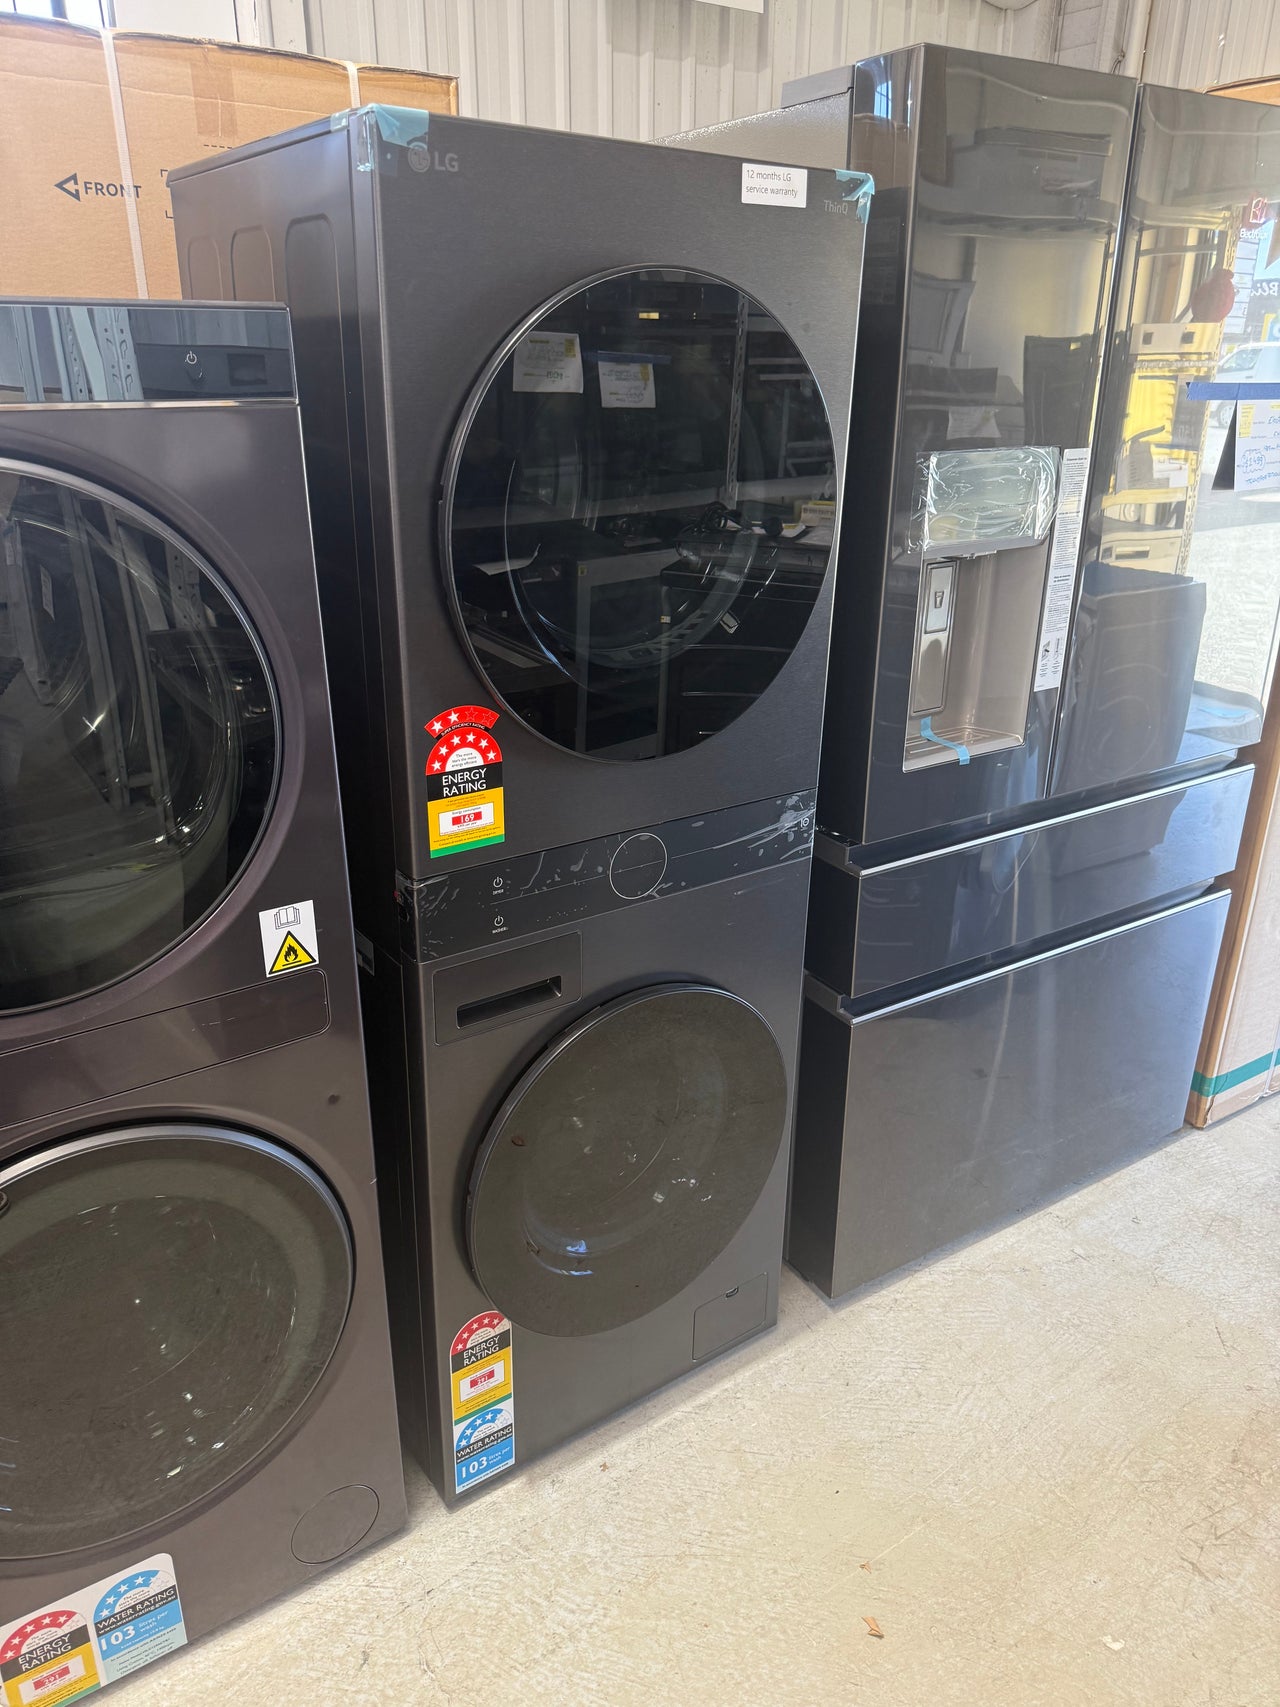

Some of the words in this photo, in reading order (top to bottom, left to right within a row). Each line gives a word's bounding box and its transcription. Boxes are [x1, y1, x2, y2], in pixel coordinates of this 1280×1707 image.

[434, 151, 459, 172] LG
[746, 169, 755, 179] 12
[756, 170, 781, 182] months
[782, 173, 792, 182] LG
[745, 184, 769, 194] service
[769, 187, 798, 198] warranty
[823, 200, 848, 214] ThinQ
[441, 728, 452, 736] SUPER
[472, 722, 485, 730] RATING
[442, 768, 487, 786] ENERGY
[443, 780, 487, 797] RATING
[461, 814, 474, 824] 169
[463, 1336, 500, 1358] ENERGY
[464, 1344, 499, 1366] RATING
[457, 1441, 484, 1457] WATER
[484, 1426, 512, 1444] RATING
[462, 1456, 488, 1478] 103
[97, 1608, 134, 1628] WATER
[136, 1588, 174, 1610] RATING
[101, 1625, 136, 1650] 103
[18, 1634, 70, 1664] ENERGY
[22, 1643, 72, 1672] RATING
